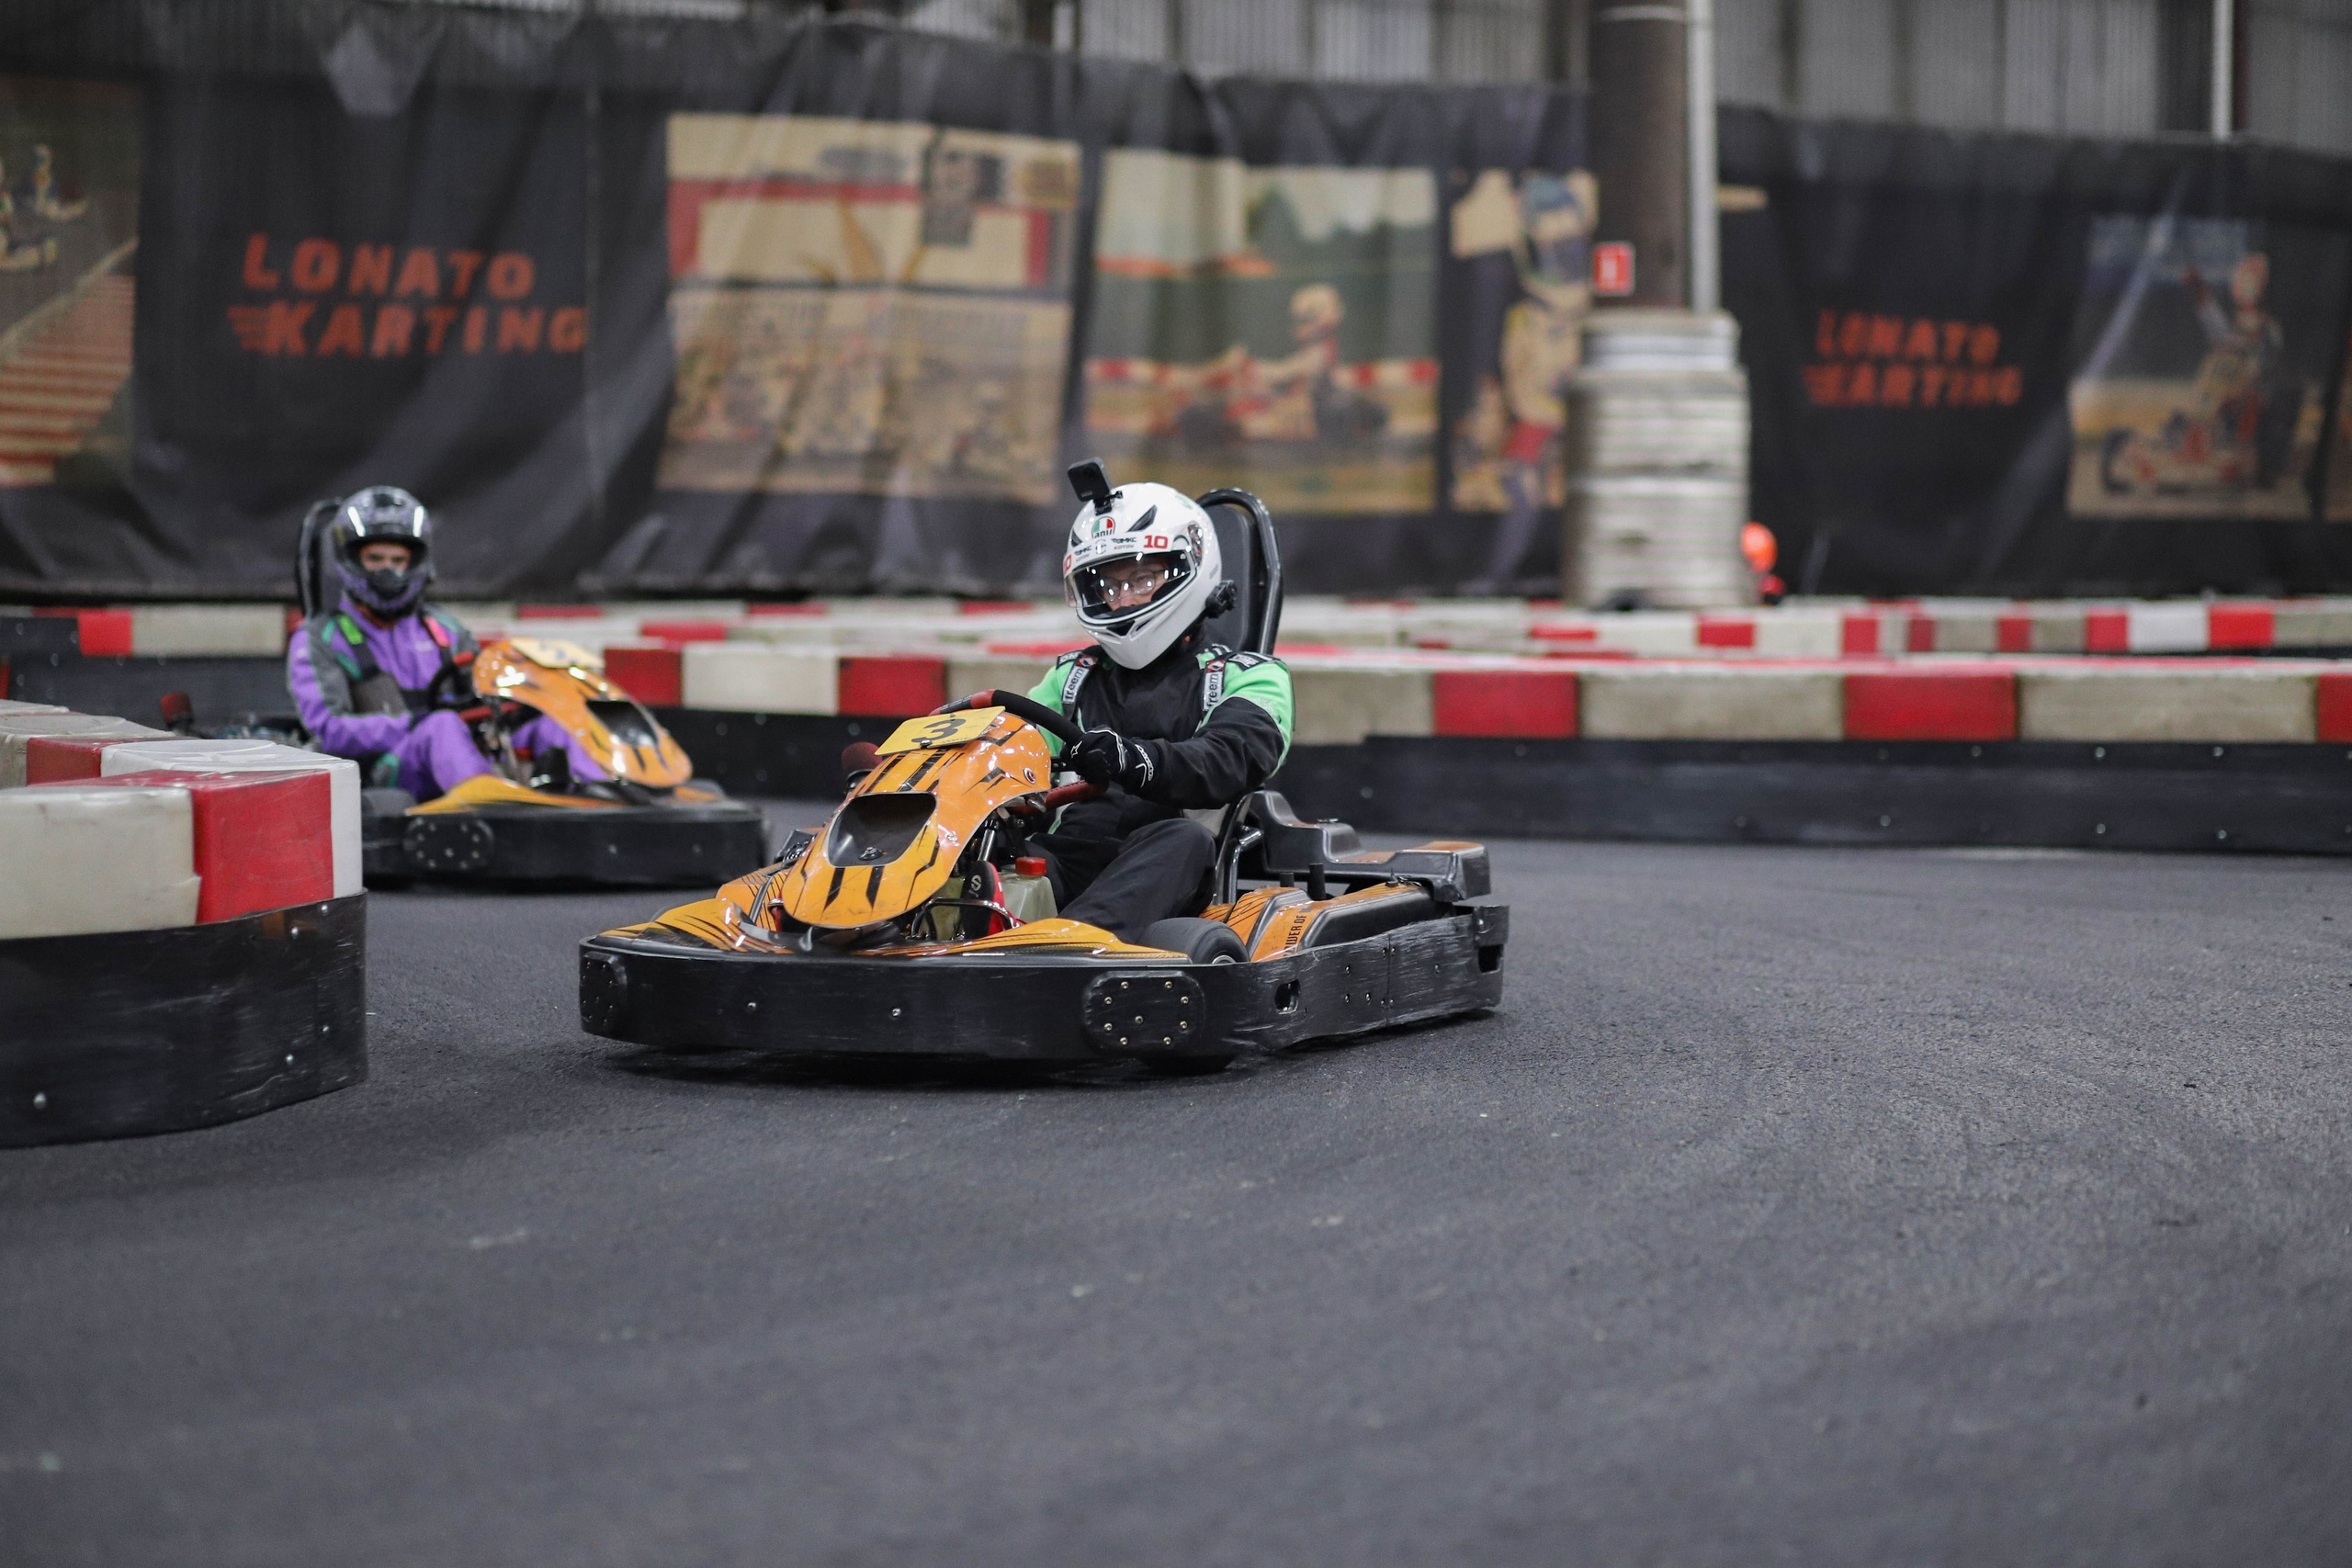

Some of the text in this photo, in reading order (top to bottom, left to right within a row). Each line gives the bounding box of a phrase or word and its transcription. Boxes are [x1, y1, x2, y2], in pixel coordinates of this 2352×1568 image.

[243, 231, 537, 301] LONATO
[261, 299, 589, 359] KARTING
[1815, 307, 2001, 364] LONATO
[1143, 535, 1169, 549] 10
[1065, 668, 1085, 700] freem
[1206, 673, 1218, 707] freem
[910, 718, 967, 743] 3
[1294, 915, 1307, 924] OF
